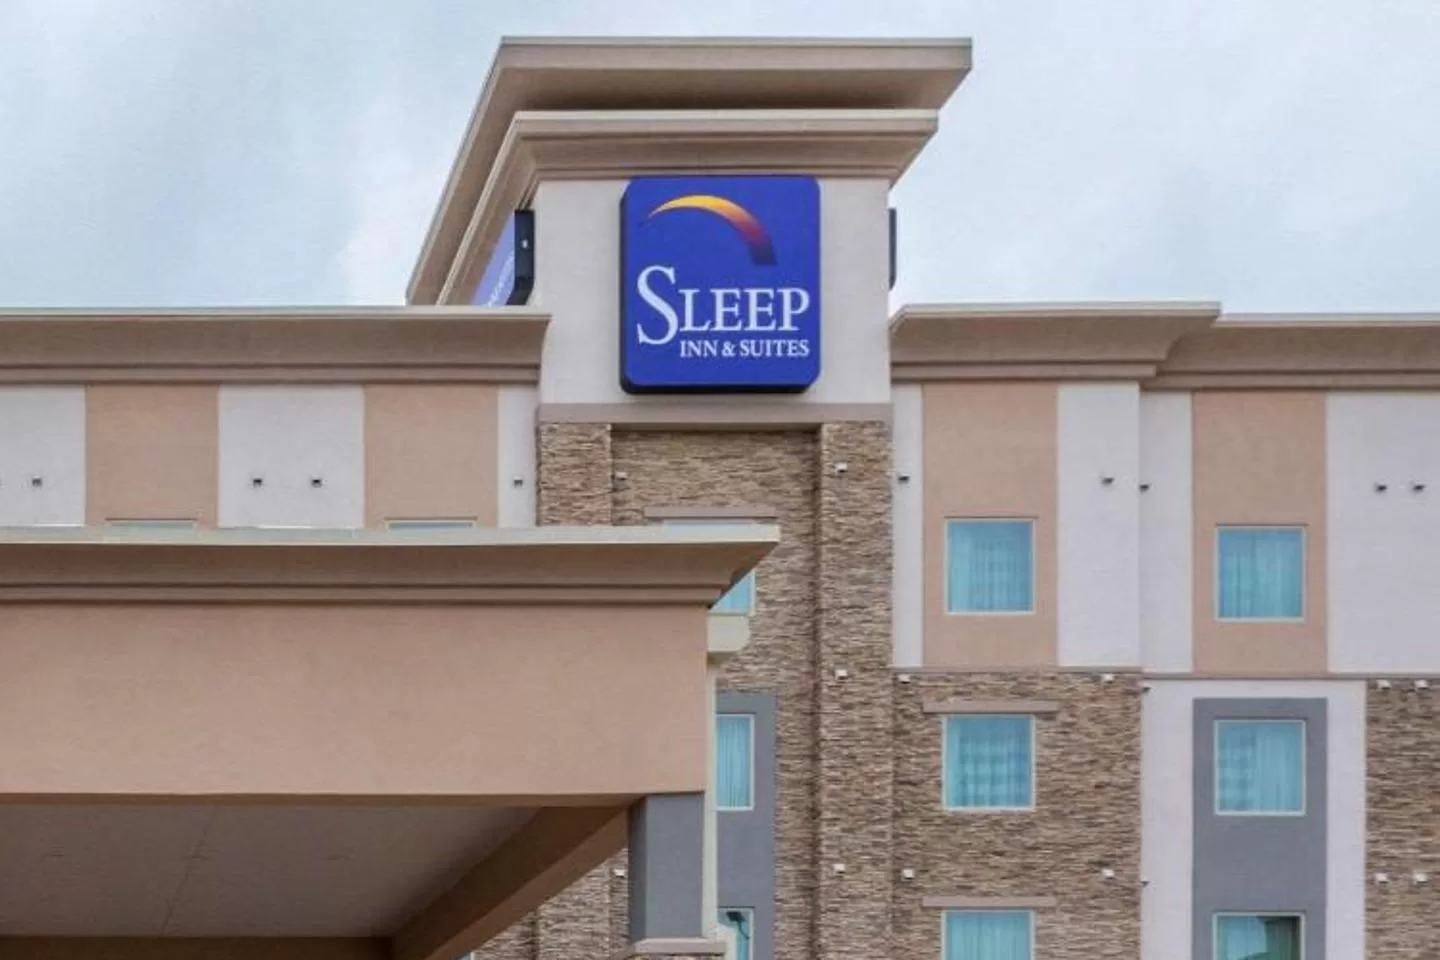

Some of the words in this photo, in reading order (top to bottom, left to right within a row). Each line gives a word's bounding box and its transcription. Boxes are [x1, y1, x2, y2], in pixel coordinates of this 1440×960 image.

[636, 264, 810, 345] SLEEP
[679, 340, 718, 357] INN
[721, 340, 736, 357] &
[739, 339, 810, 357] SUITES
